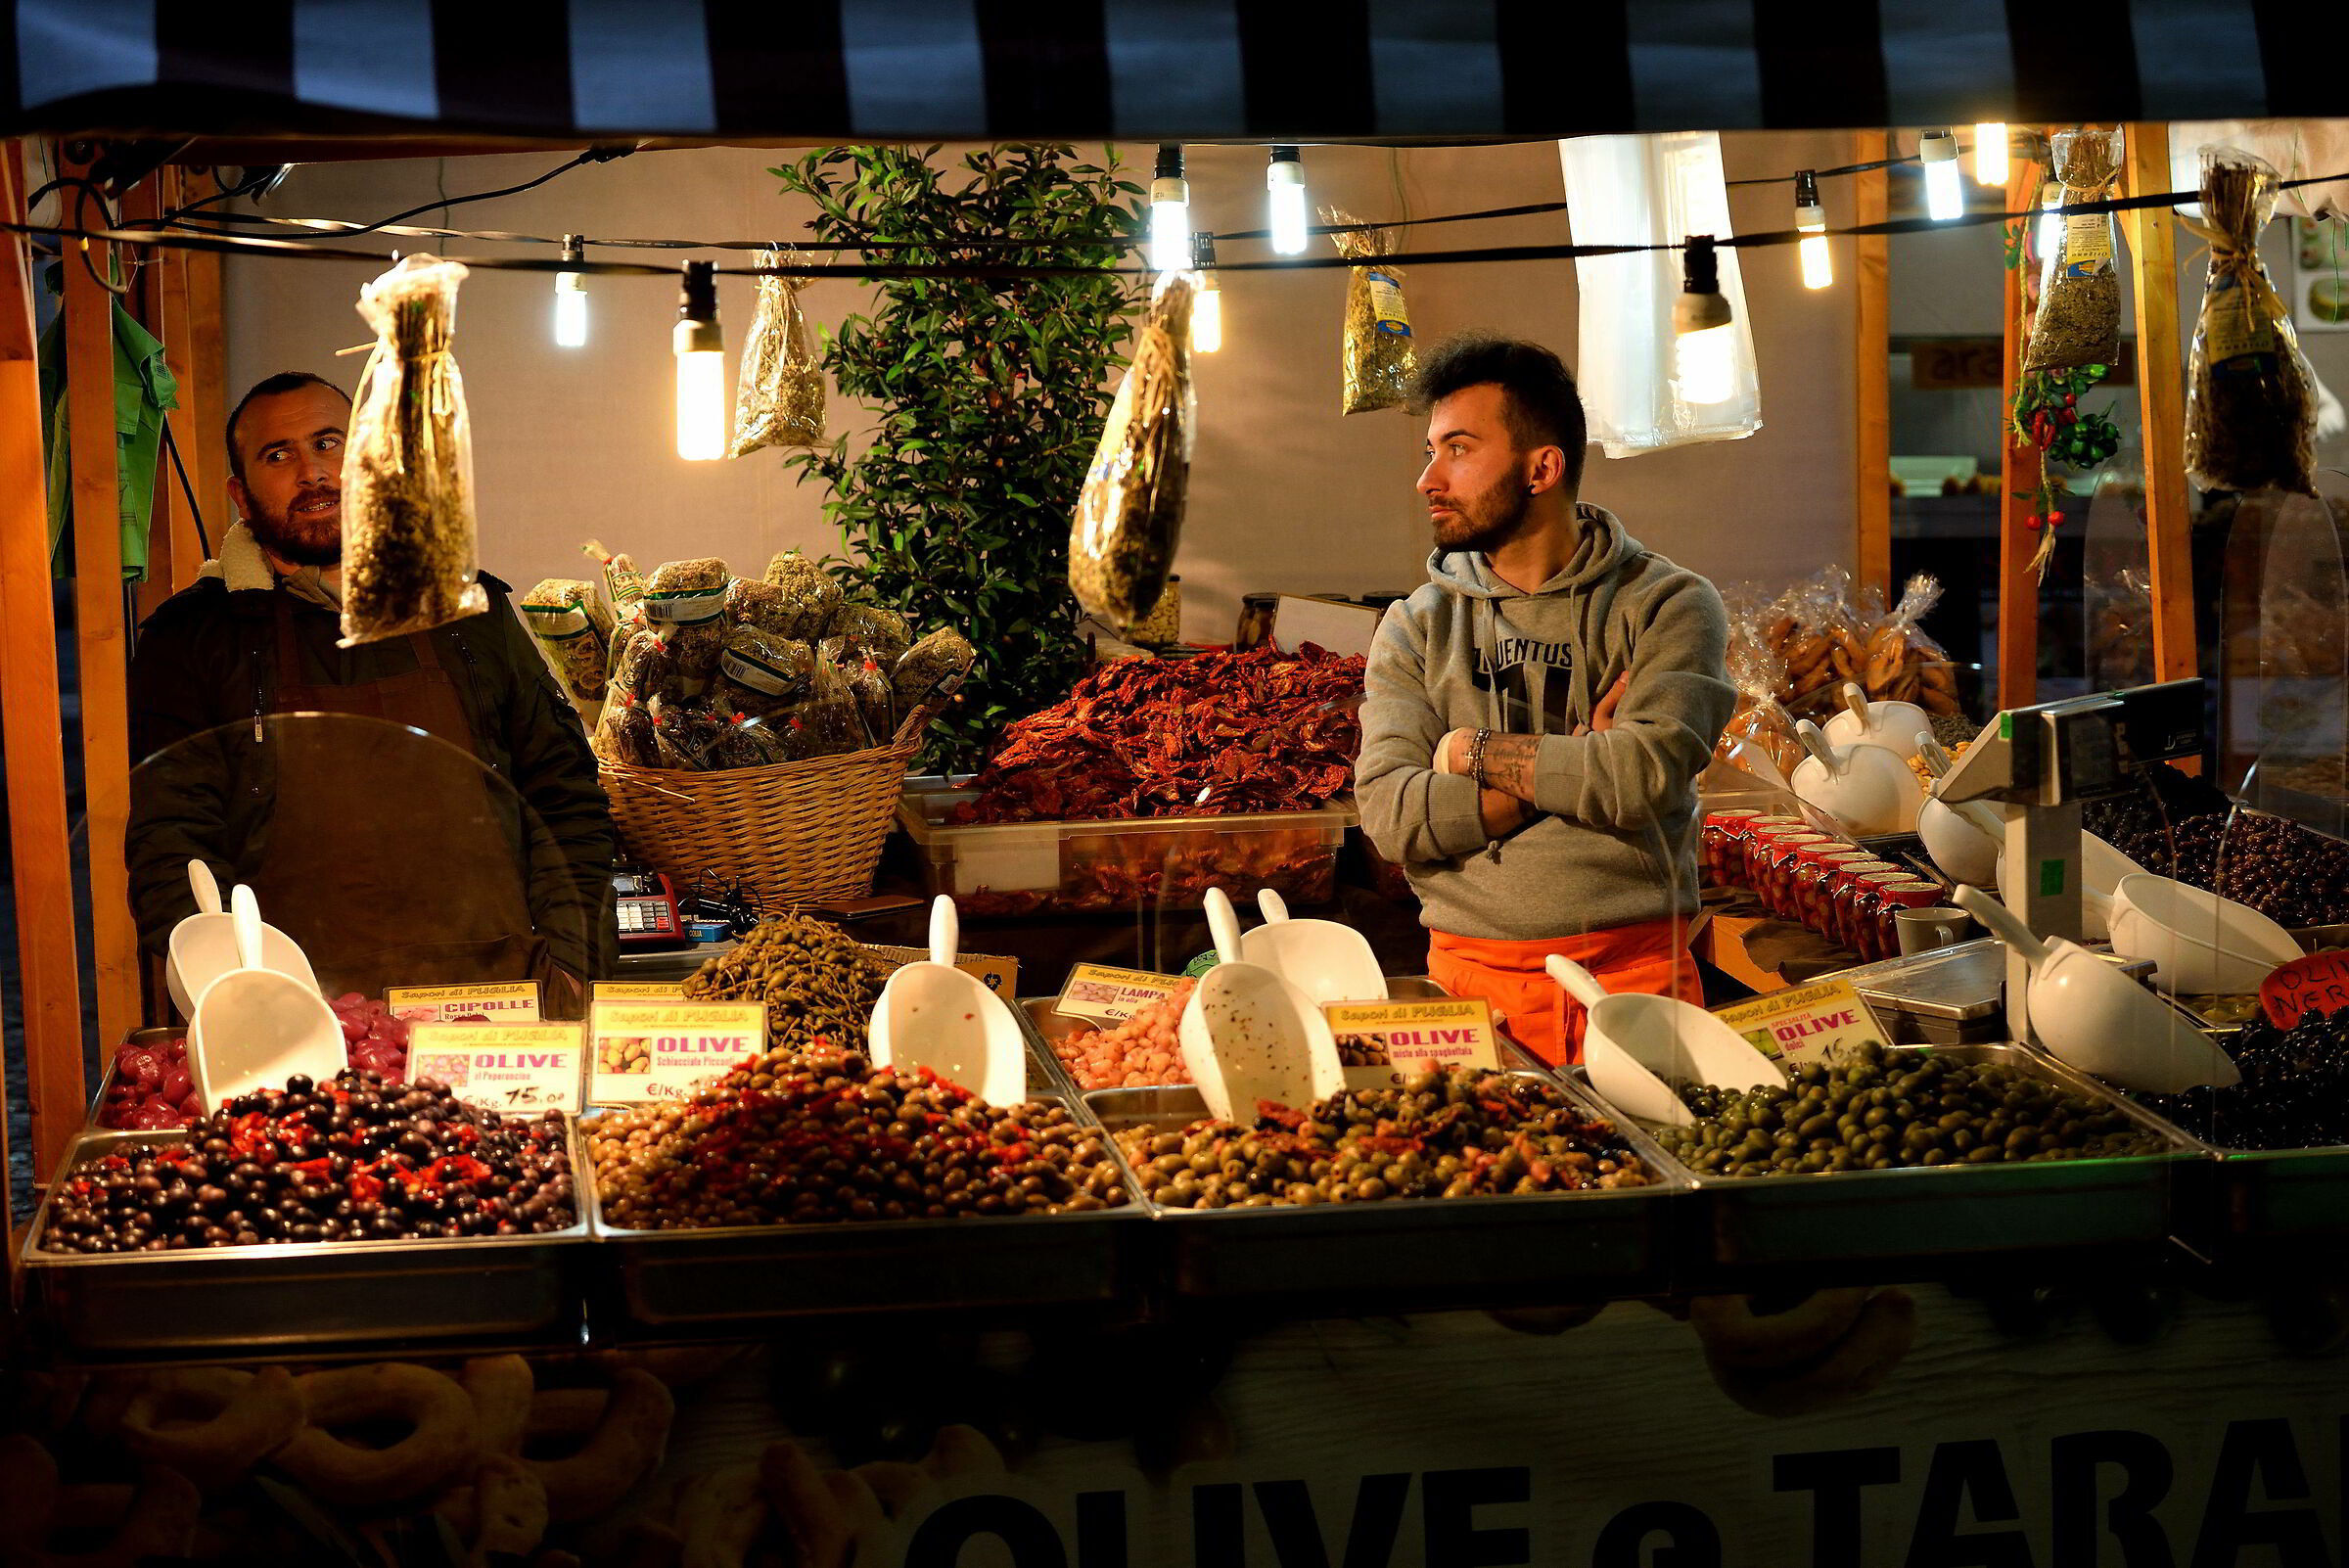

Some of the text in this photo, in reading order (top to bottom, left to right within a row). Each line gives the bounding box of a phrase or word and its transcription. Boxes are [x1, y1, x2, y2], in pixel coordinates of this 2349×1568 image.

[449, 987, 463, 996] di
[467, 985, 526, 995] PUGLIA
[1120, 987, 1167, 1000] LAMPA
[1782, 983, 1842, 1008] PUGLIA
[444, 998, 534, 1013] CIPOLLE
[2273, 986, 2349, 1018] NER
[1411, 1004, 1475, 1020] PUGLIA
[1774, 1009, 1861, 1041] OLIVE
[657, 1037, 750, 1053] OLIVE
[1390, 1029, 1480, 1045] OLIVE
[475, 1053, 568, 1068] OLIVE
[1773, 1415, 2349, 1568] TARA
